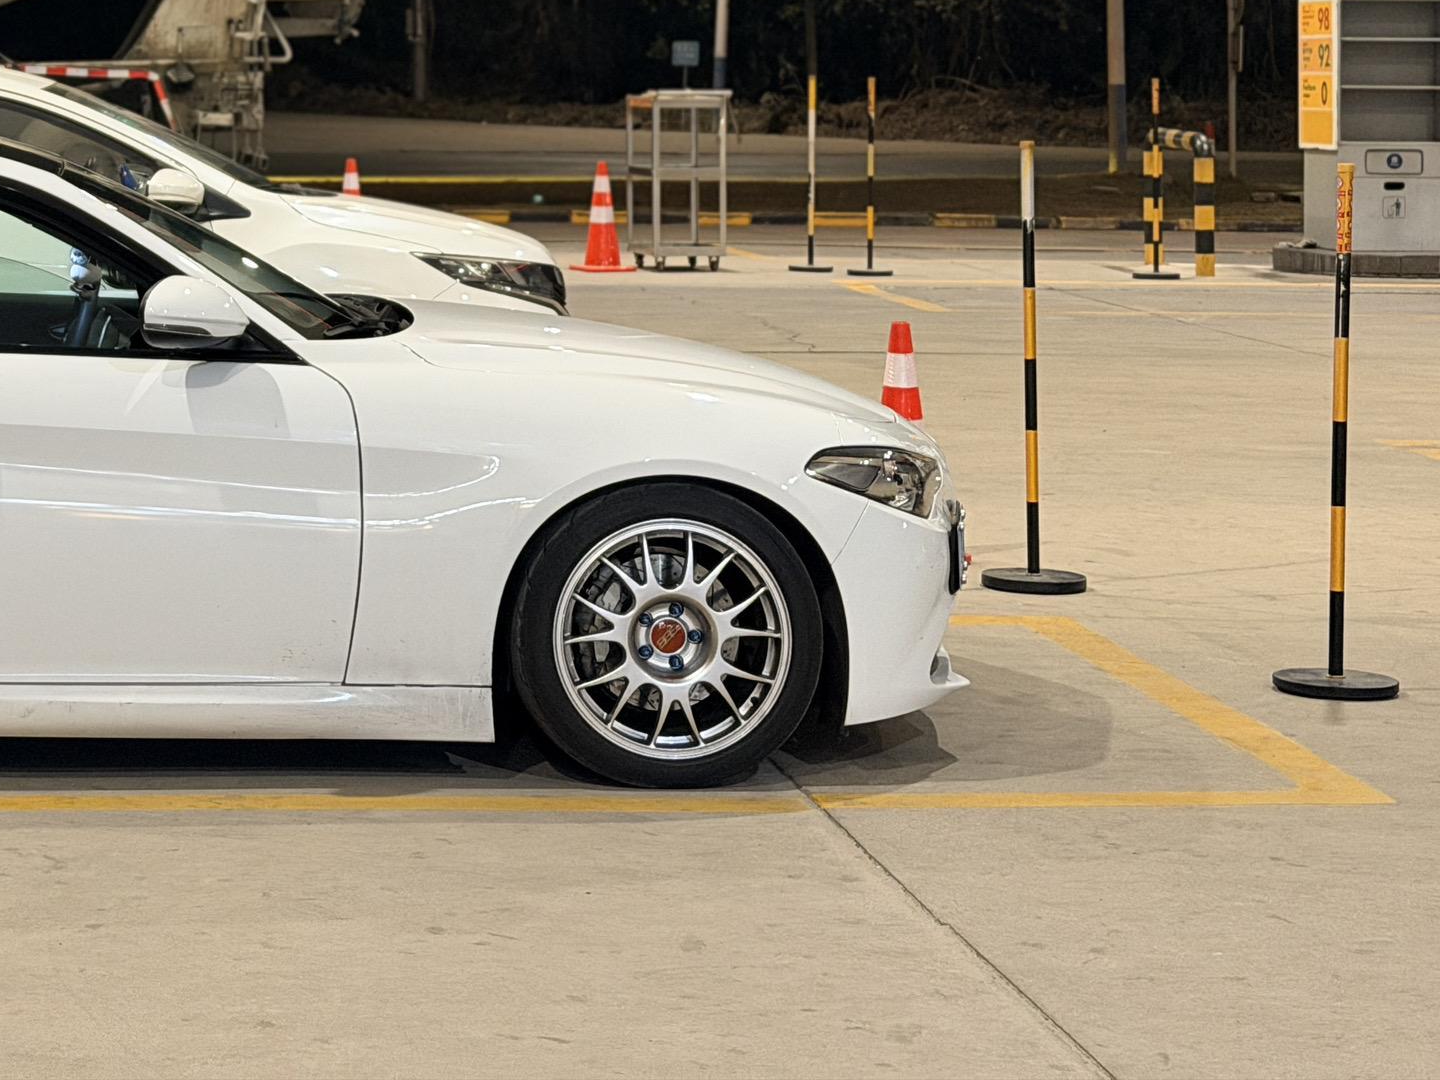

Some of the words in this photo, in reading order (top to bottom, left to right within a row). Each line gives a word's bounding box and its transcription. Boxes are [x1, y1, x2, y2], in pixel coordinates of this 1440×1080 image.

[1318, 8, 1330, 30] 98
[1318, 44, 1330, 68] 92
[1321, 81, 1327, 105] 0
